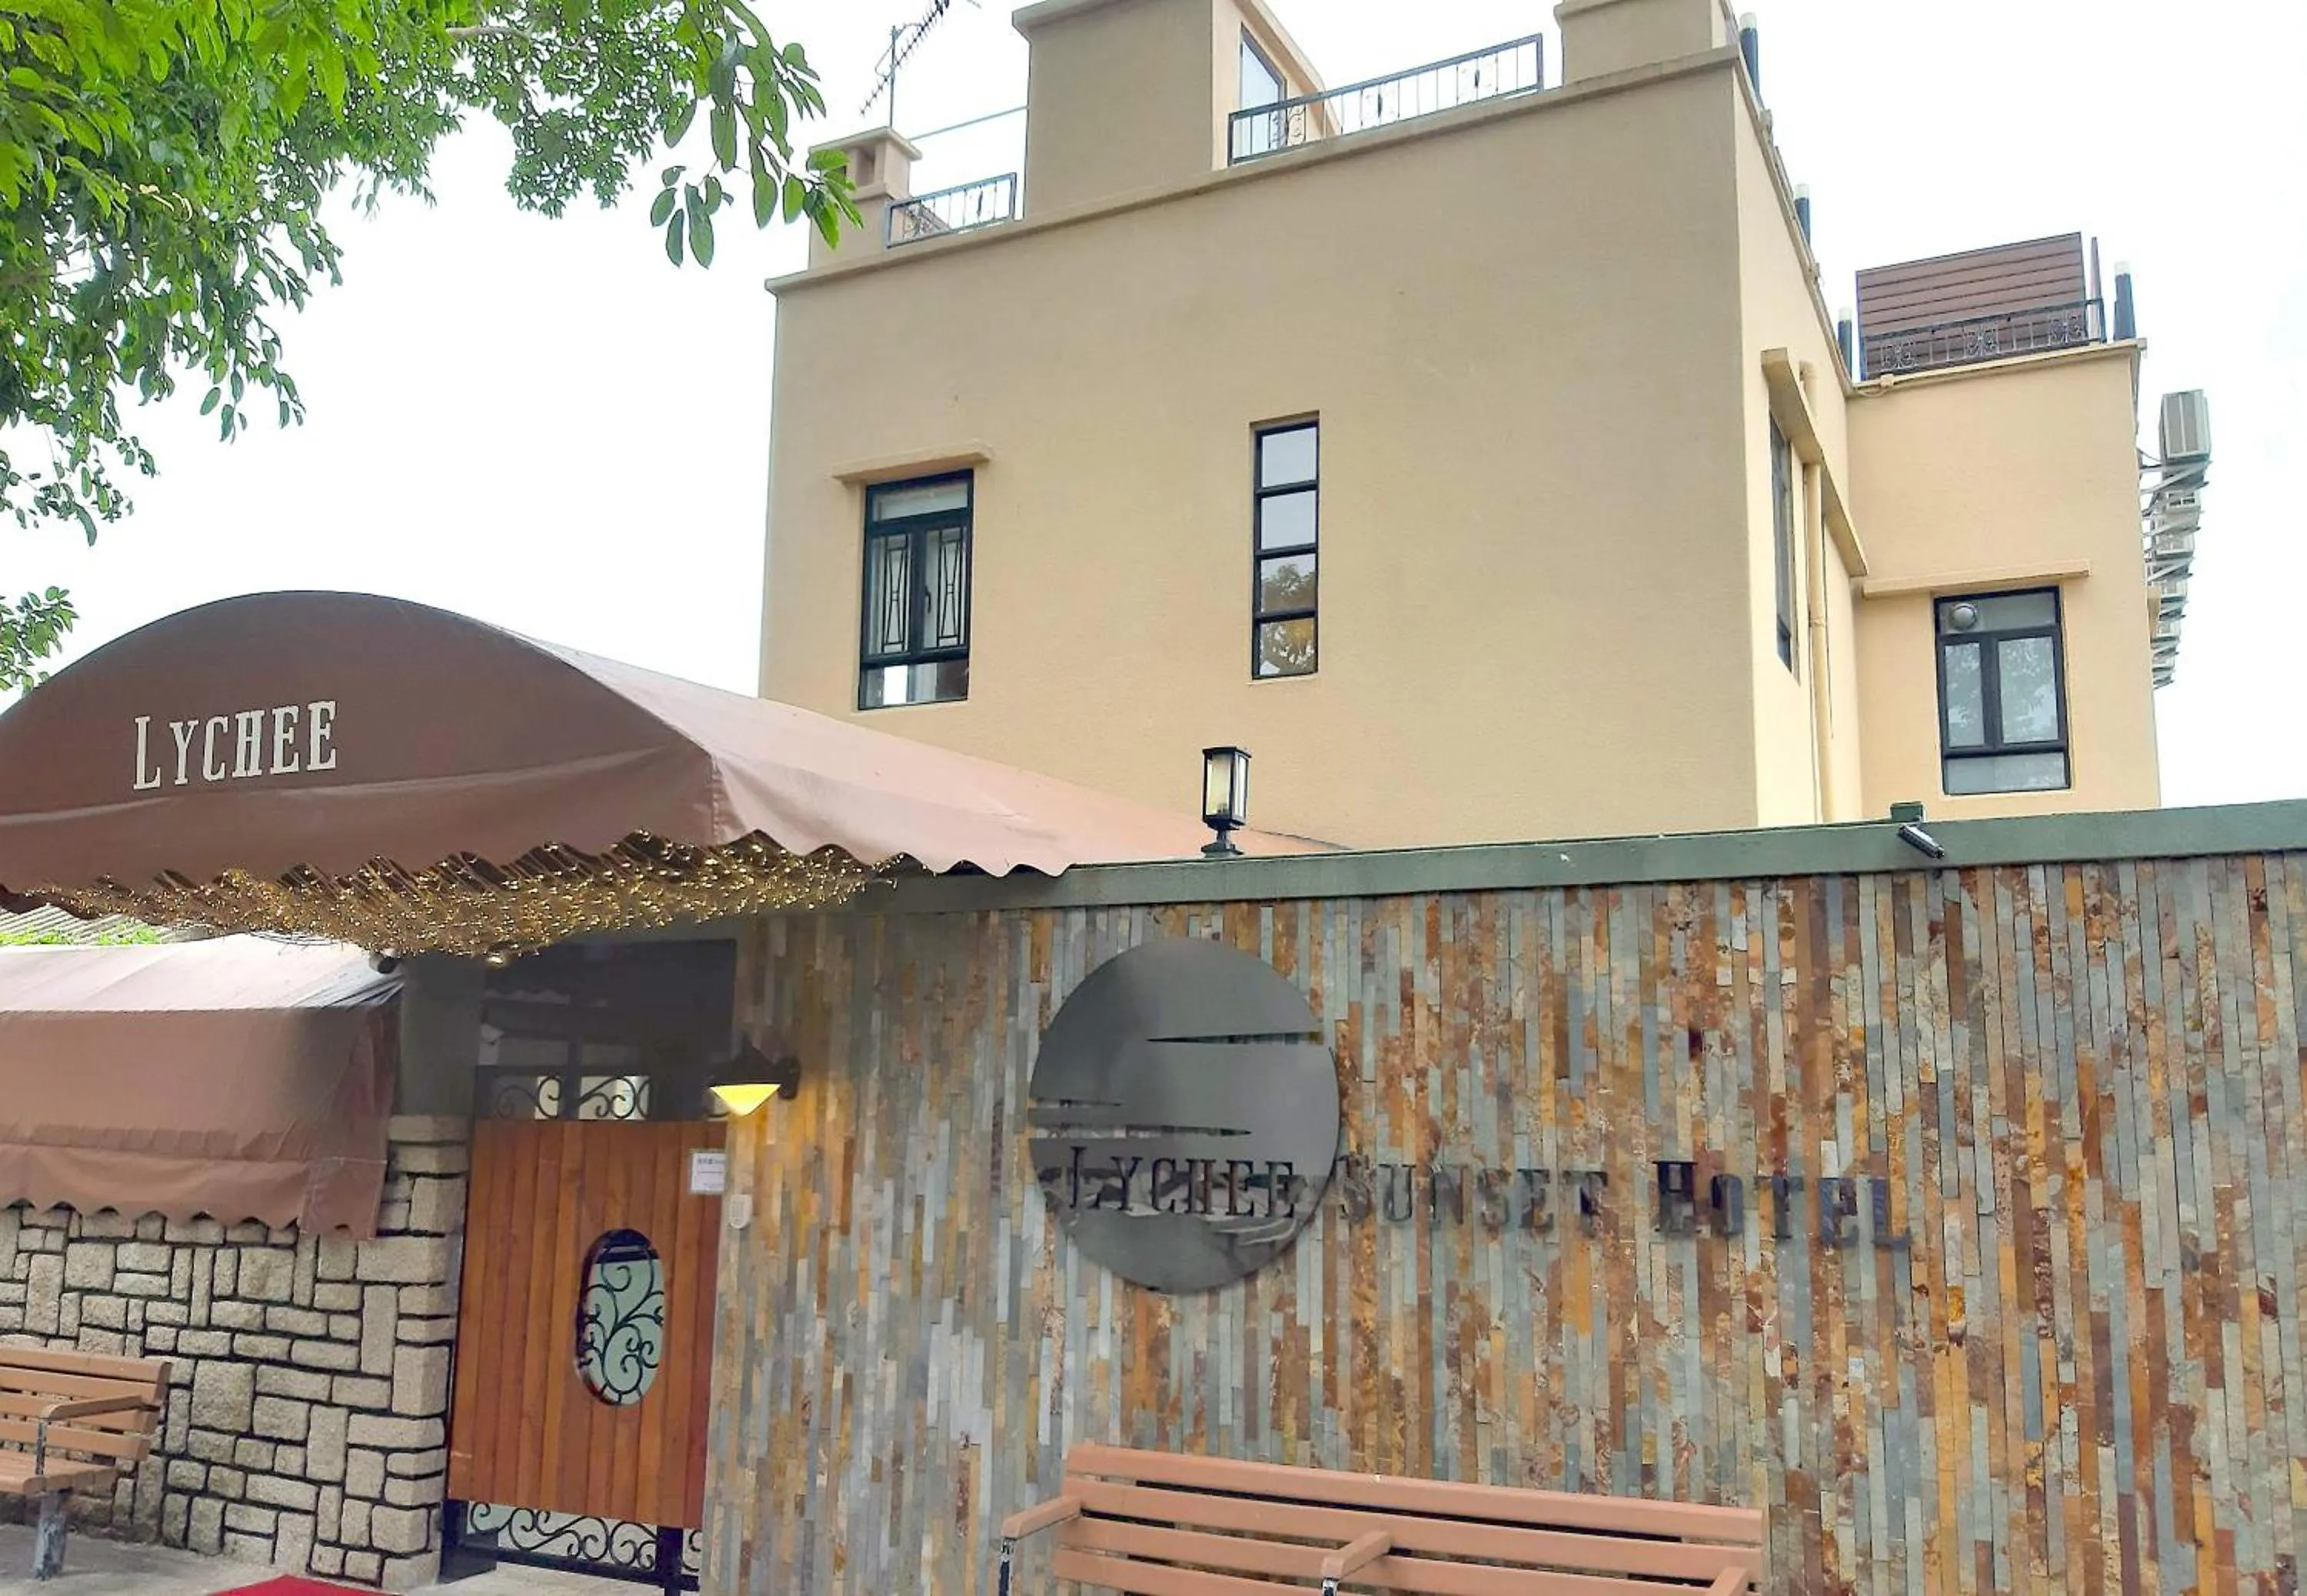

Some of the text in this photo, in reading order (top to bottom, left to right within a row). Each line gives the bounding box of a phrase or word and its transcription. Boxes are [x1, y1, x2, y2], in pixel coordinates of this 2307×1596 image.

[132, 700, 338, 791] LYCHEE
[1067, 1145, 1910, 1250] LYCHEE SUNSET HOTEL
